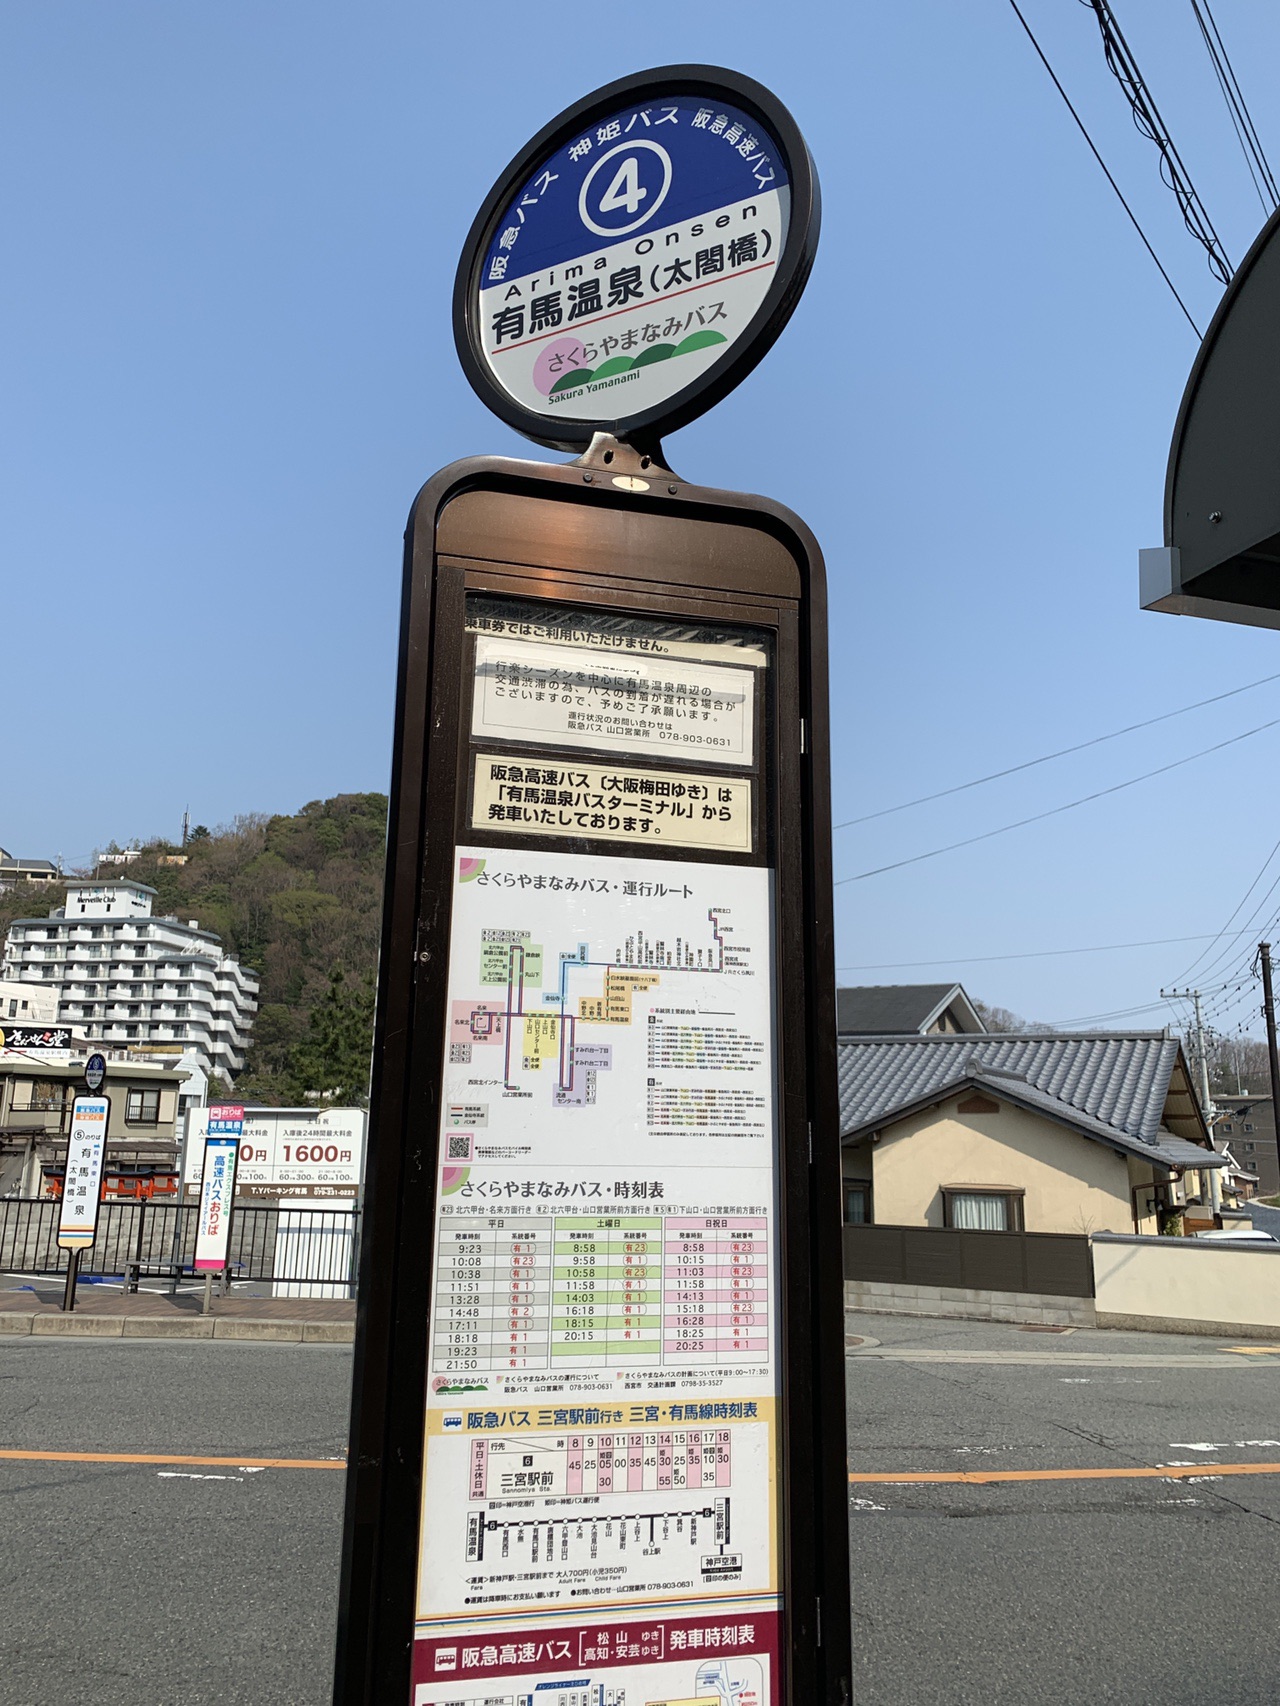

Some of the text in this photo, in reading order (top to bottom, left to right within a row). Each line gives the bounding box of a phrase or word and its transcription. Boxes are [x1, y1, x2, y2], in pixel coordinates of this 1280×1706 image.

[488, 106, 776, 281] 阪急バス 神姫バス 阪急高速バス
[505, 204, 758, 301] Arima Onsen
[548, 301, 728, 373] さくらやまなみバス
[548, 370, 641, 405] Sakura Yamanami
[495, 660, 713, 697] 行楽シーズンを中心に有馬温泉周辺の
[495, 674, 737, 713] 交通渋滞の為、バスの到着が遅れる場合が
[494, 686, 720, 723] ございますので、予めご了承願います。
[567, 711, 673, 731] 運行状況のお問い合わせは
[567, 720, 604, 733] 阪急バス
[606, 724, 651, 739] 山口営業所
[498, 784, 732, 822] 「有馬温泉バスターミナル」から
[488, 803, 663, 834] 発車いたしております。
[476, 871, 694, 899] さくらやまなみバス・運行ルート
[103, 896, 117, 904] Club
[282, 1144, 352, 1163] 1600円
[460, 1180, 665, 1199] さくらやまなみバス・時刻表
[207, 1155, 226, 1236] 高速バスおりば
[488, 1219, 505, 1229] 平日
[596, 1219, 621, 1229] 土曜日
[705, 1219, 728, 1229] 日祝日
[458, 1244, 482, 1254] 9:23
[573, 1243, 596, 1253] 8:58
[683, 1243, 705, 1253] 8:58
[451, 1257, 482, 1266] 10:08
[572, 1256, 596, 1265] 9:58
[677, 1256, 704, 1264] 10:15
[451, 1270, 482, 1279] 10:38
[566, 1268, 596, 1278] 10:58
[677, 1268, 704, 1277] 11:03
[450, 1283, 480, 1292] 11:51
[566, 1281, 595, 1290] 11:58
[677, 1280, 705, 1289] 11:58
[450, 1295, 480, 1304] 13:28
[566, 1293, 595, 1302] 14:03
[677, 1292, 704, 1301] 14:13
[449, 1308, 480, 1317] 14:48
[565, 1306, 595, 1315] 16:18
[677, 1305, 705, 1313] 15:18
[448, 1321, 478, 1330] 17:11
[565, 1319, 594, 1328] 18:15
[676, 1317, 704, 1326] 16:28
[448, 1334, 478, 1343] 18:18
[564, 1331, 594, 1341] 20:15
[676, 1329, 704, 1338] 18:25
[447, 1347, 478, 1356] 19:23
[675, 1342, 704, 1351] 20:25
[446, 1360, 478, 1369] 21:50
[467, 1402, 758, 1430] 阪急バス 三宮駅前行き 三宮・有馬線時刻表
[490, 1432, 729, 1451] 行先 時 8 9 10 11 12 13 14 15 16 17 18
[524, 1456, 531, 1466] 6
[568, 1454, 729, 1470] 45 25 05 00 35 45 30 25 35 10 30
[500, 1472, 554, 1487] 三宮駅前
[599, 1472, 715, 1487] 30 55 50 35
[716, 1503, 724, 1540] 三宮駅前
[468, 1517, 478, 1556] 有馬温泉
[705, 1556, 738, 1567] 神戸空港
[641, 1631, 660, 1641] ゆき
[670, 1624, 755, 1651] 発車時刻表
[461, 1640, 572, 1669] 阪急高速バス
